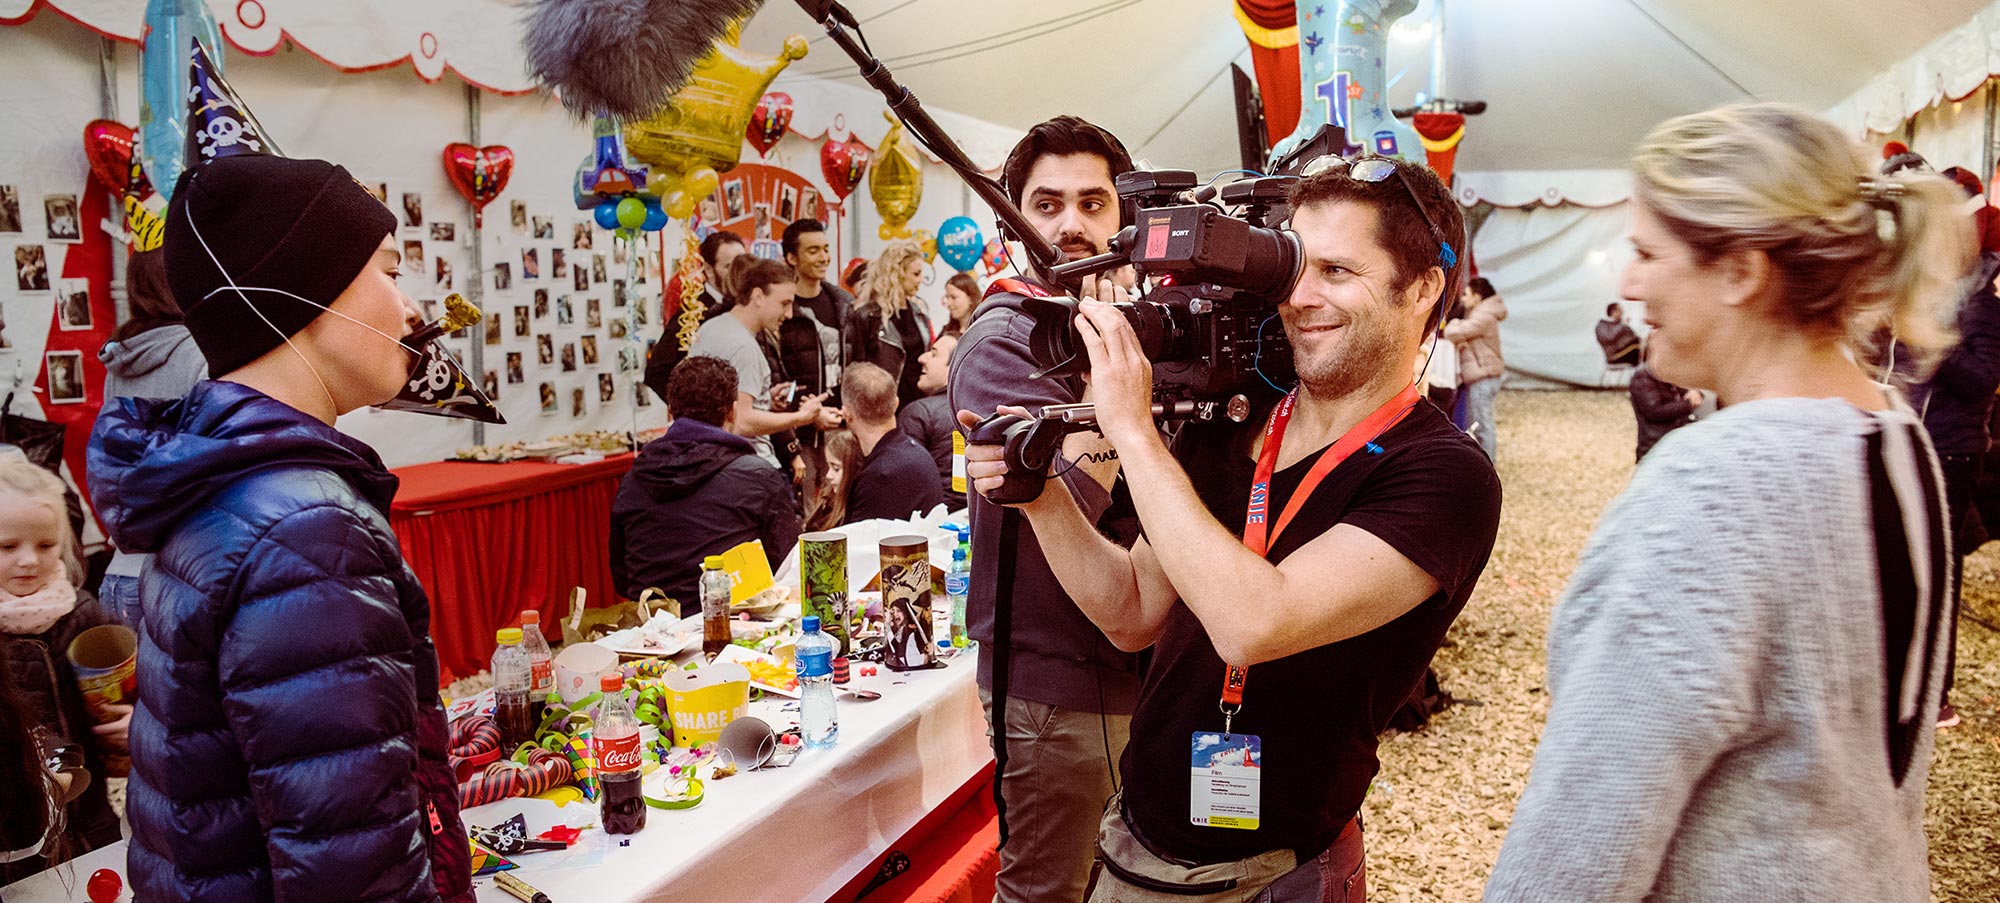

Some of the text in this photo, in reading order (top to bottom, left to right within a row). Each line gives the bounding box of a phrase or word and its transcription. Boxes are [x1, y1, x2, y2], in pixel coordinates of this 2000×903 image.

[1171, 229, 1190, 237] SONY
[1247, 481, 1268, 525] KNIE
[674, 709, 729, 730] SHARE
